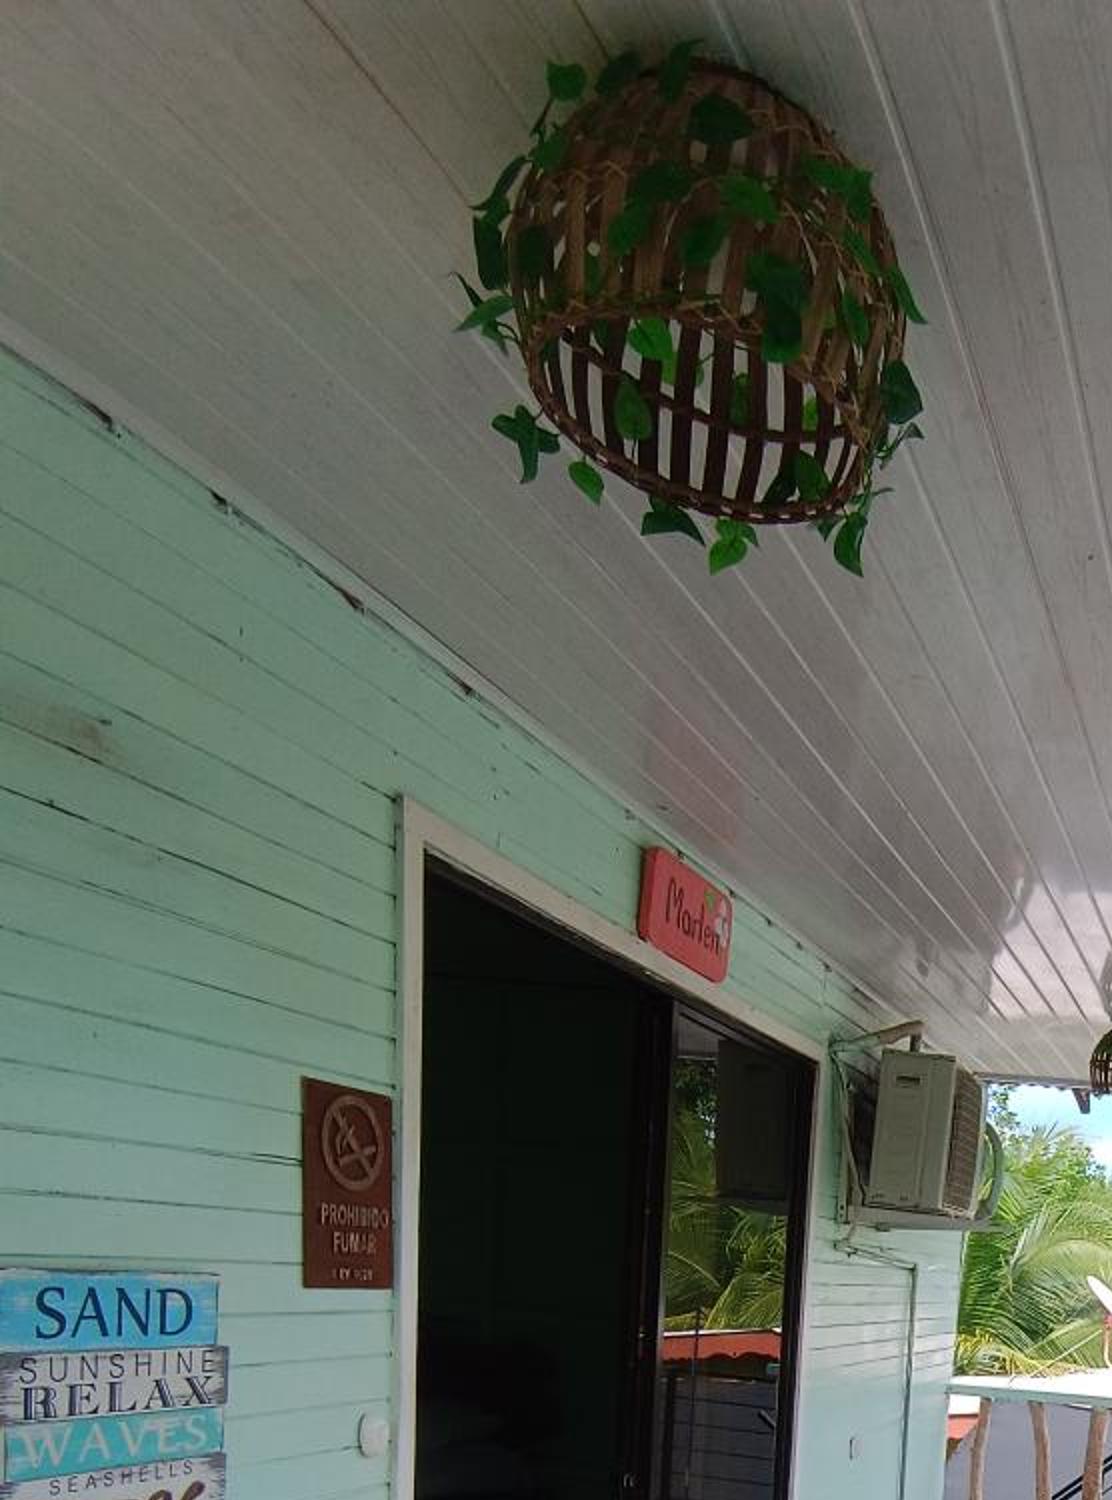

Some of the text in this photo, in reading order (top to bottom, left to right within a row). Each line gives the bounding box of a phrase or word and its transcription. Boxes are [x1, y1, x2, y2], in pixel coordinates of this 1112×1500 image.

[35, 1286, 193, 1339] SAND
[19, 1349, 215, 1384] SUNSHINE
[20, 1375, 213, 1421] RELAX
[18, 1413, 209, 1469] WAVES
[49, 1460, 193, 1496] SEASHELLS
